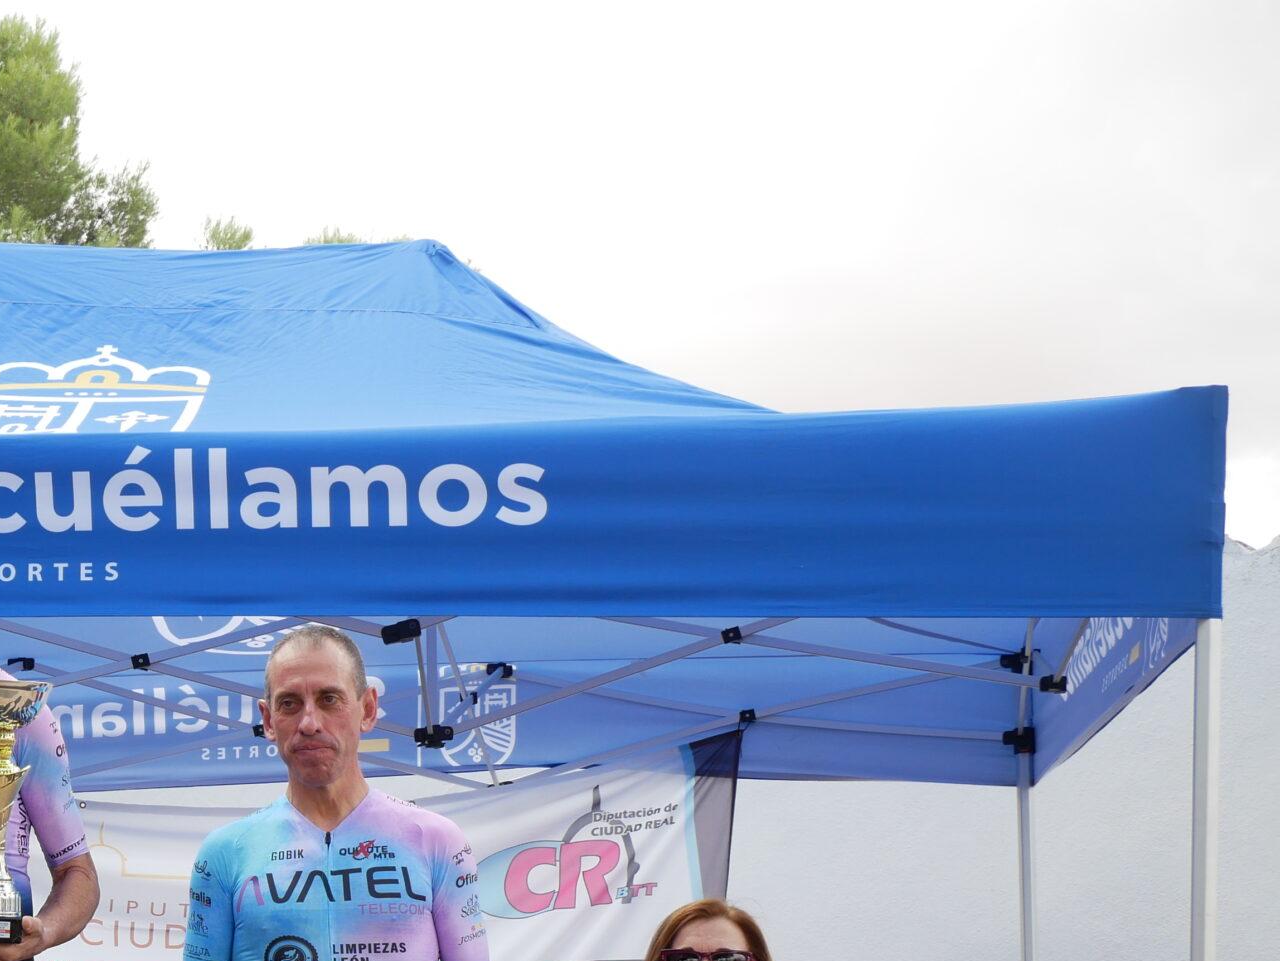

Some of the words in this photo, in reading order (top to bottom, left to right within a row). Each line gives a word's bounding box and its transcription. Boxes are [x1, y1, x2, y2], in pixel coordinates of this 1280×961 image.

[593, 807, 661, 823] Diputación
[663, 803, 678, 813] de
[591, 823, 643, 837] CIUDAD
[644, 816, 676, 830] REAL
[271, 848, 304, 861] GOBIK
[373, 852, 396, 860] MTB
[504, 839, 620, 914] CR
[236, 866, 427, 913] AVATEL
[615, 882, 658, 900] BTT
[109, 899, 190, 918] IPUT
[80, 918, 187, 950] CIUD
[332, 942, 407, 955] LIMPIEZAS
